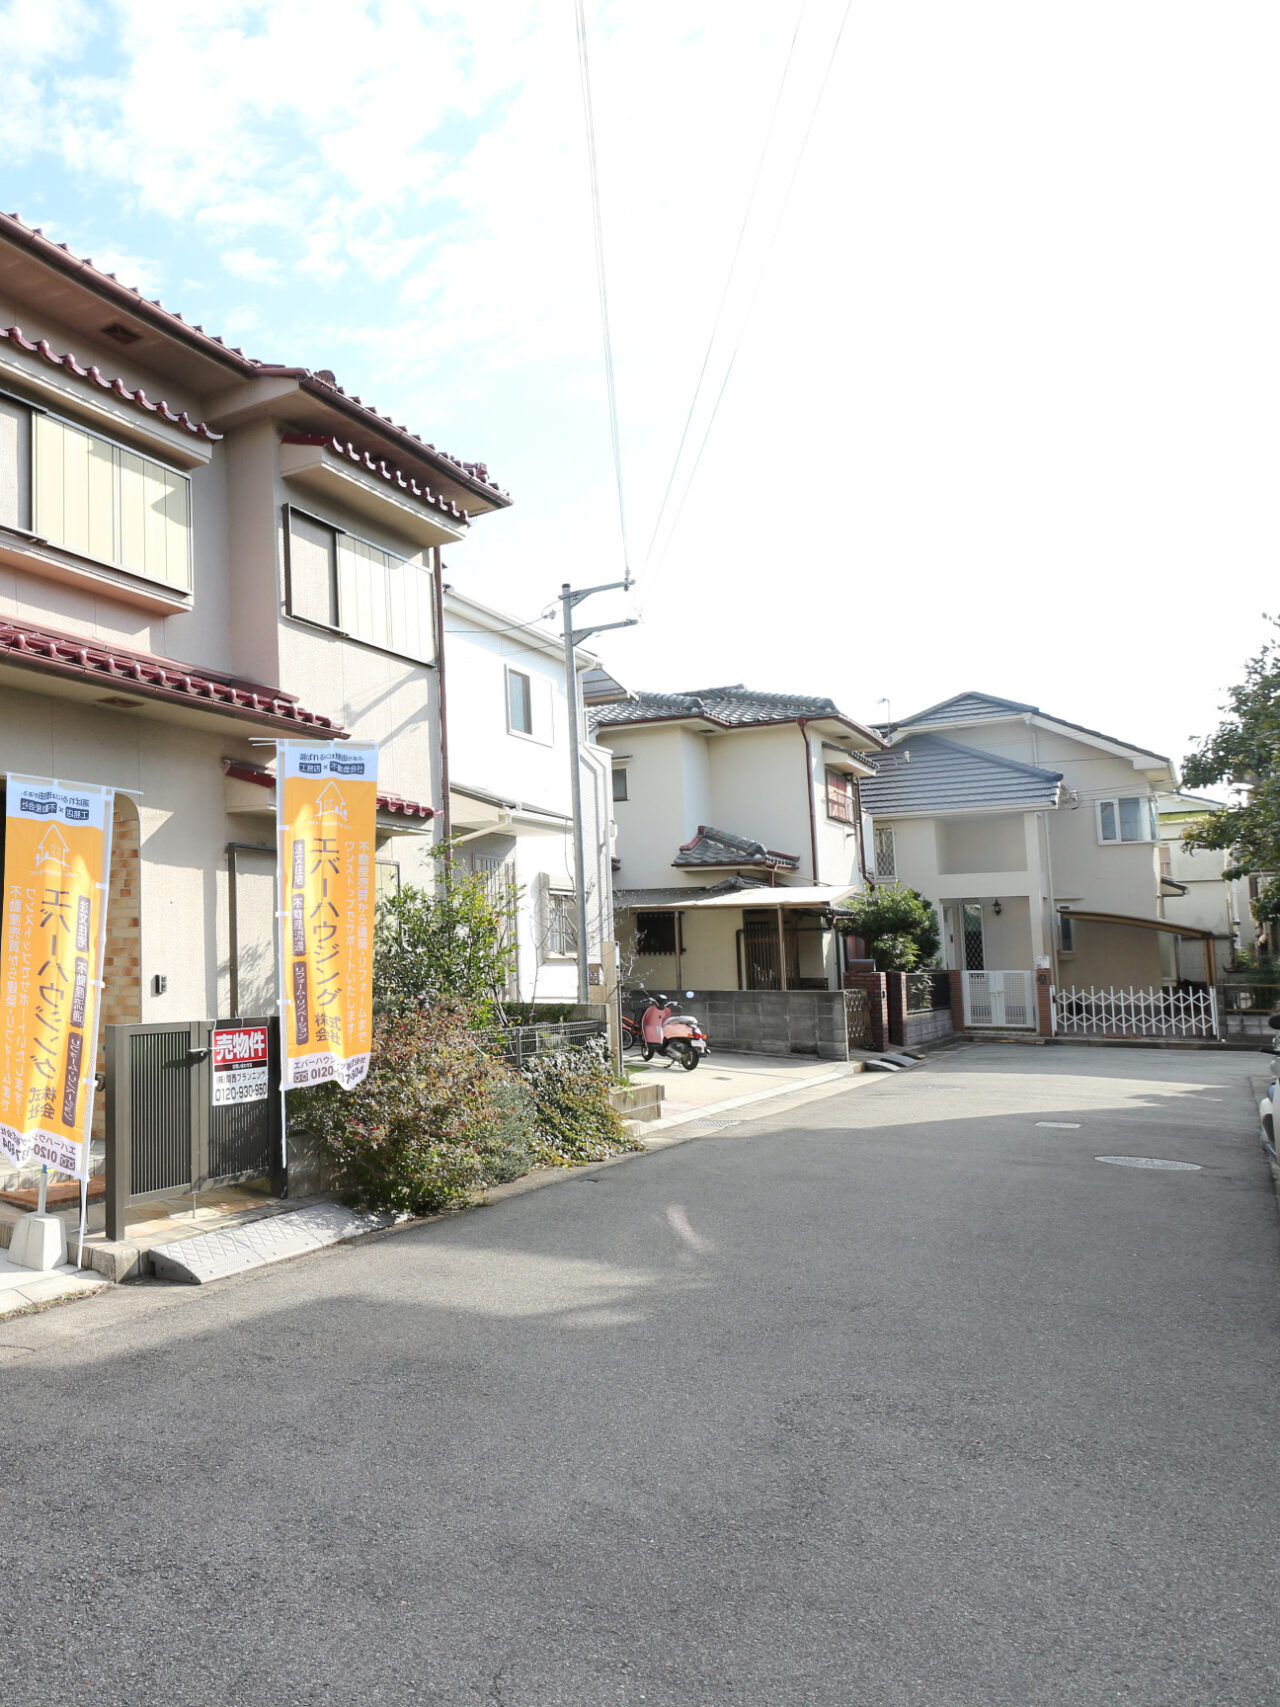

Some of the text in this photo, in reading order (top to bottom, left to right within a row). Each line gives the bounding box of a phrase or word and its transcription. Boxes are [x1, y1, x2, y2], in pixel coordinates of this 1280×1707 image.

[310, 837, 342, 1006] エバーハウジング
[216, 1031, 265, 1060] 売物件
